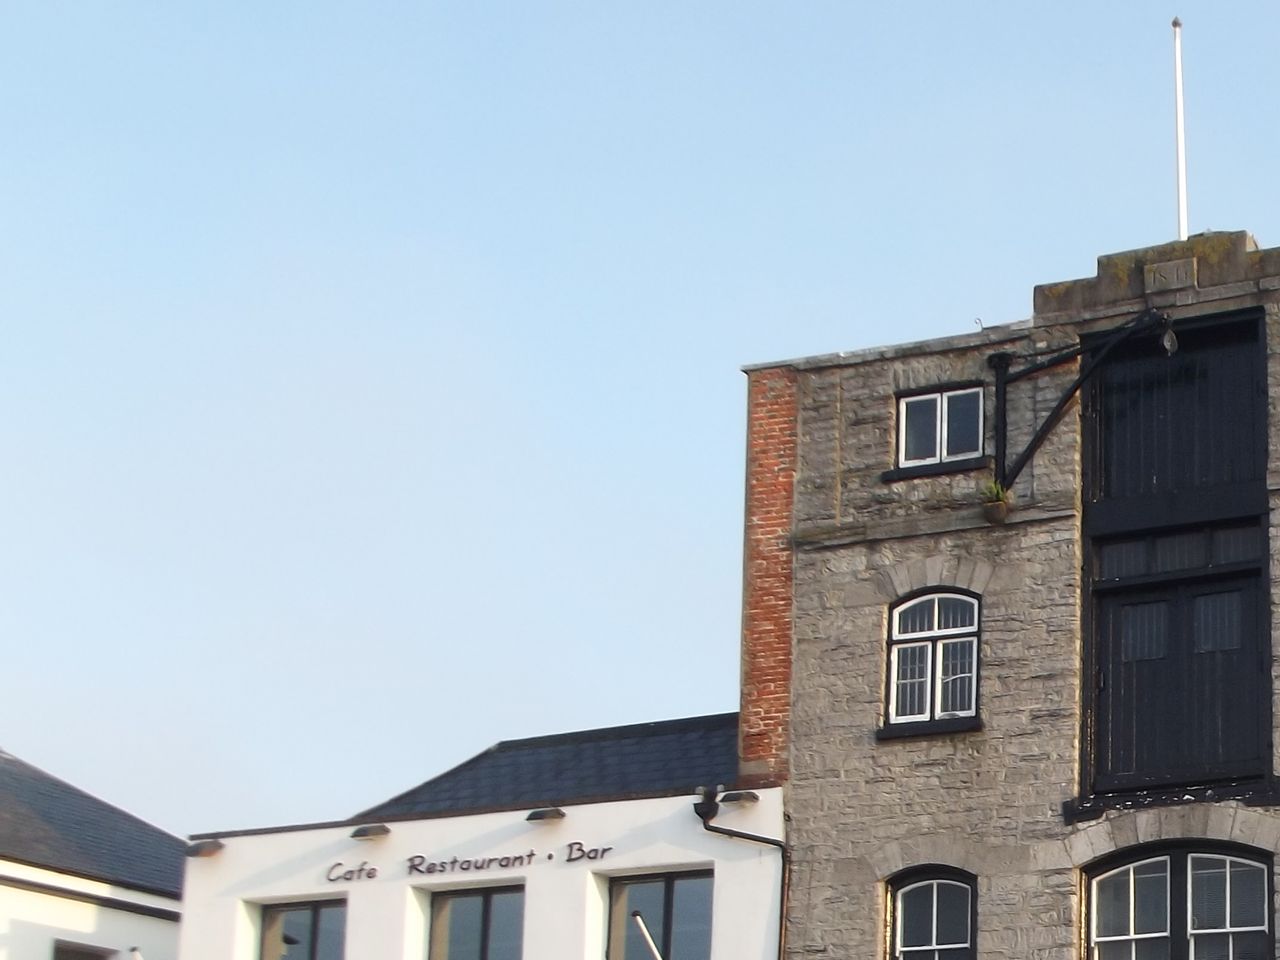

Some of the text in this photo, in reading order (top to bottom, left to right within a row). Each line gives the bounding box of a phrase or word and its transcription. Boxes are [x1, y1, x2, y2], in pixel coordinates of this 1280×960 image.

[326, 841, 613, 882] Cafe Restaurant Bar
